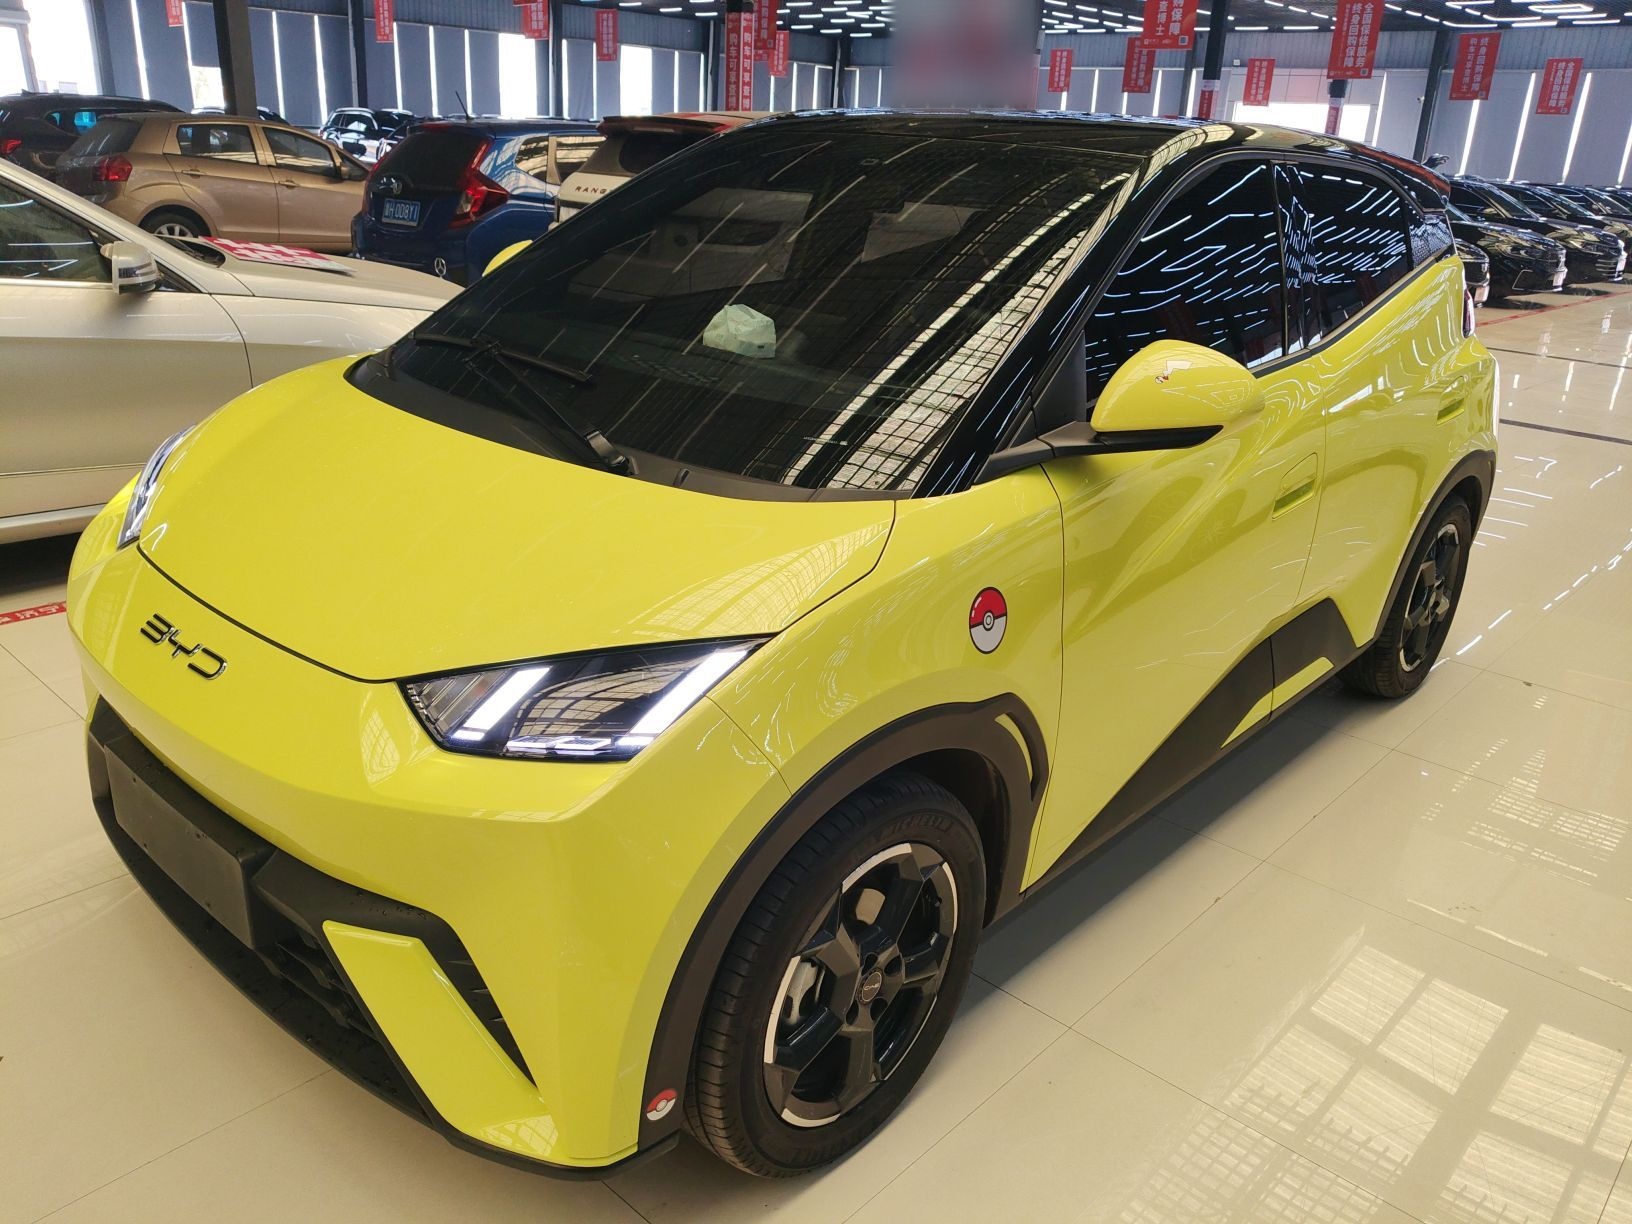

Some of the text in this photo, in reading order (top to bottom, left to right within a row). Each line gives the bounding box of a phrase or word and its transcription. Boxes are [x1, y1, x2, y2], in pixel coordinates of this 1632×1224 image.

[1344, 3, 1363, 68] 终身回购保障
[1355, 3, 1374, 67] 全国保修服务
[729, 33, 738, 111] 购车可享查博
[575, 186, 610, 195] RANG
[140, 613, 228, 681] BYD
